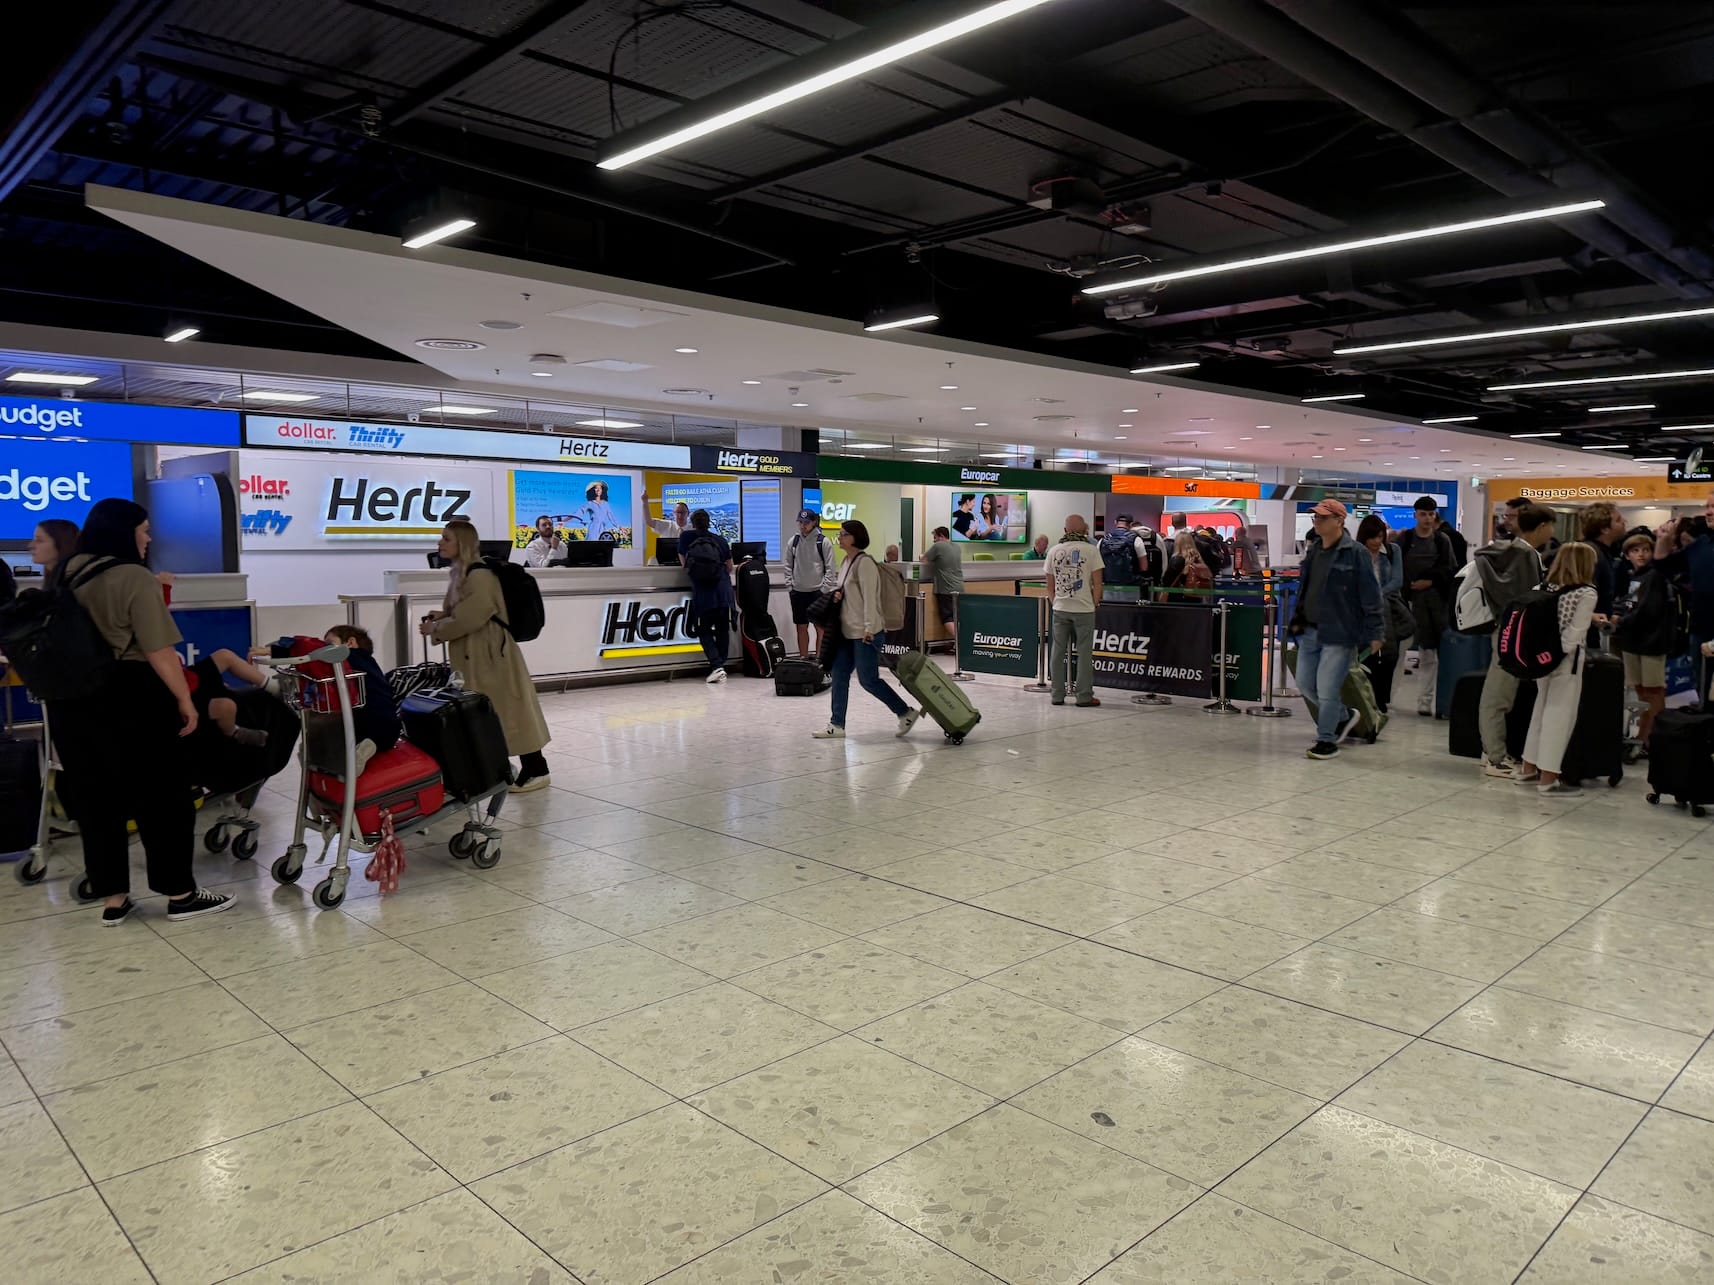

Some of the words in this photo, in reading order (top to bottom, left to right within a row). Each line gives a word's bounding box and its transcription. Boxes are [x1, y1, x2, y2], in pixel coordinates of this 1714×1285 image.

[0, 404, 83, 432] udget
[278, 422, 336, 440] dollar.
[349, 426, 405, 448] Thrifty
[560, 439, 609, 457] Hertz
[718, 450, 759, 468] Hertz
[760, 456, 779, 464] GOLD
[760, 465, 793, 473] MEMBERS
[961, 468, 1000, 484] Europcar
[0, 468, 91, 511] dget
[240, 475, 290, 495] ollar.
[1520, 488, 1576, 499] Baggage
[1579, 486, 1634, 497] Services
[327, 478, 472, 522] Hertz
[602, 599, 699, 644] Hert
[973, 632, 1022, 648] Europcar
[1092, 629, 1150, 654] Hertz
[973, 650, 994, 658] moving
[1117, 663, 1145, 675] PLUS
[1148, 665, 1203, 681] REWARDS
